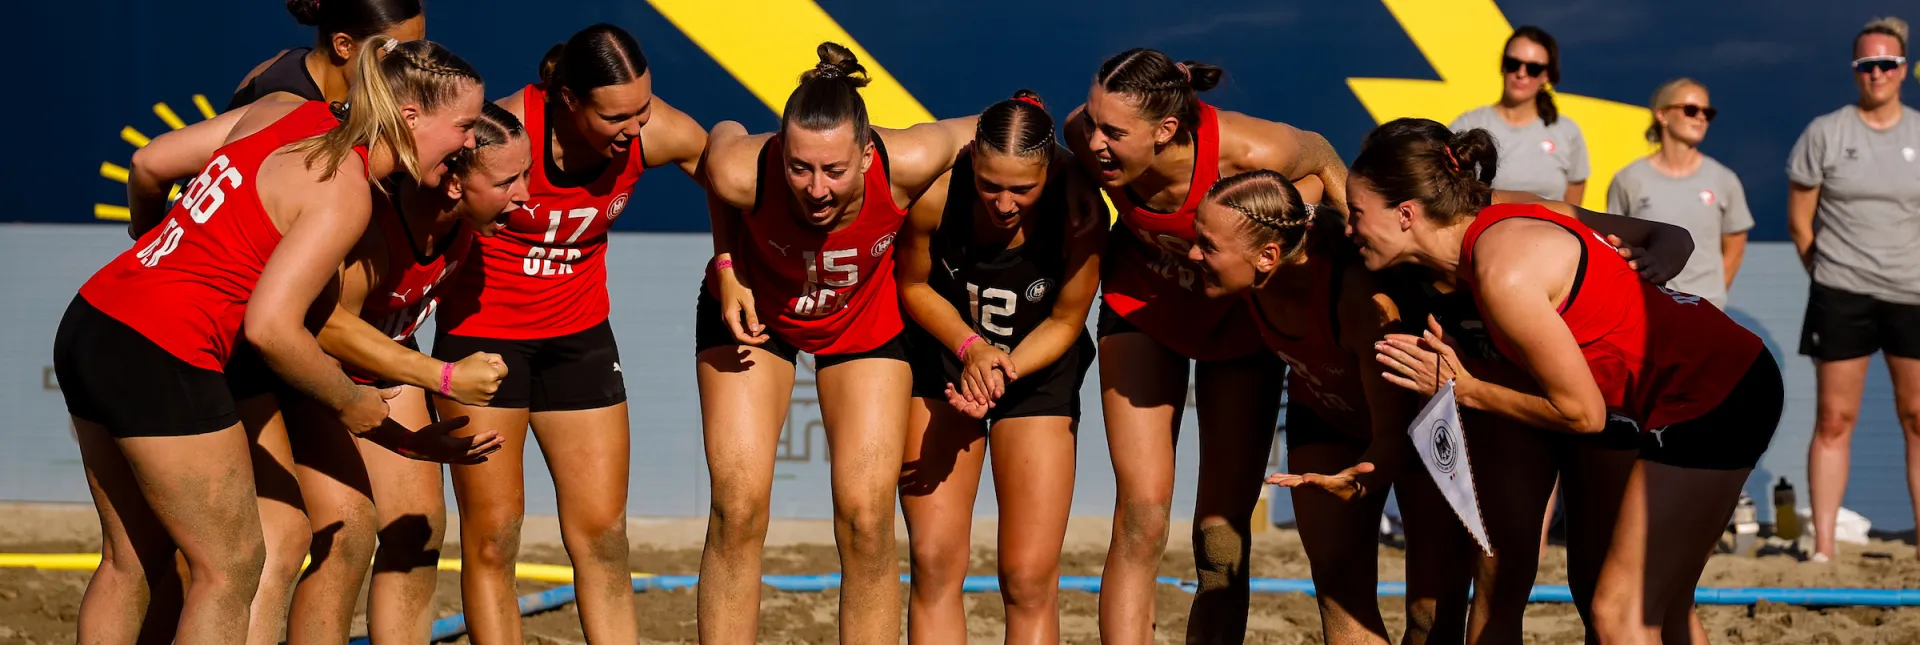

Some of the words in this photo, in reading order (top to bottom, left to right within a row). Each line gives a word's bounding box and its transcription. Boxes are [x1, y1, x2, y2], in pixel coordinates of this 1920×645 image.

[182, 154, 243, 224] 66
[136, 217, 185, 268] ER
[543, 206, 599, 246] 17
[523, 246, 582, 276] GER
[802, 248, 858, 287] 15
[966, 281, 1018, 337] 12
